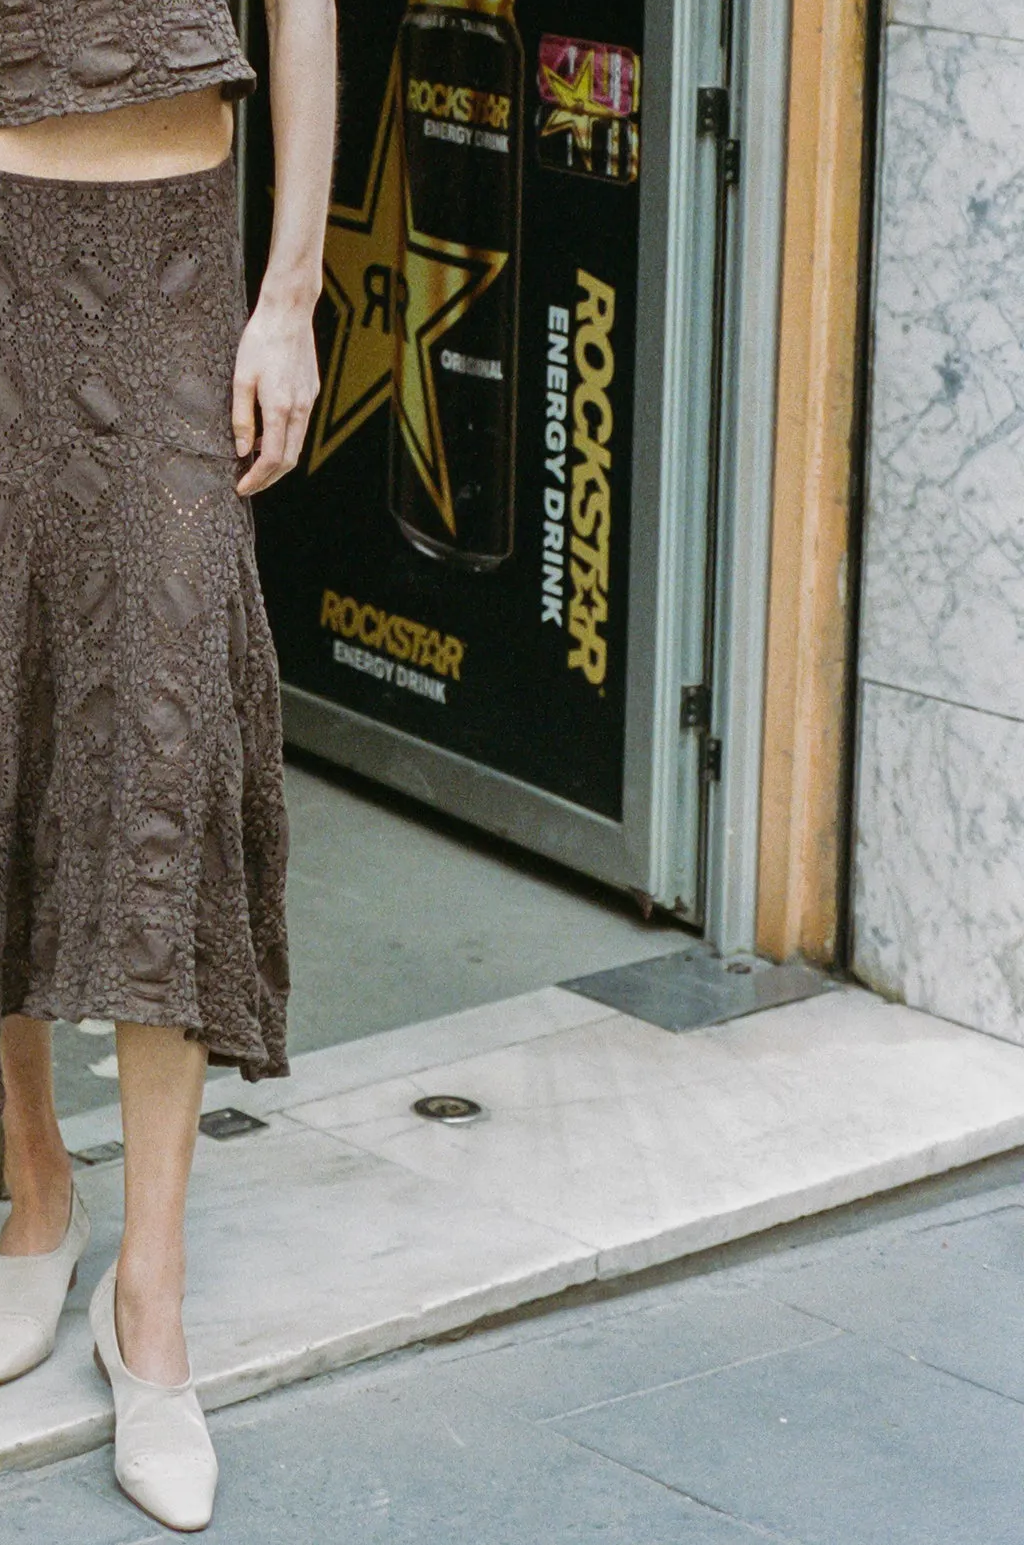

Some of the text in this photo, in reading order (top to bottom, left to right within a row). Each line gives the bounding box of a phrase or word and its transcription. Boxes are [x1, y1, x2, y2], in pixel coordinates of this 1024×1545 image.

[406, 77, 510, 130] ROCKSTAR
[424, 118, 473, 146] ENERGY
[541, 304, 569, 628] ENERGY DRINK
[569, 268, 615, 686] ROCKSTAR
[321, 589, 464, 681] ROCKSTAR
[334, 639, 446, 705] ENERGY DRINK
